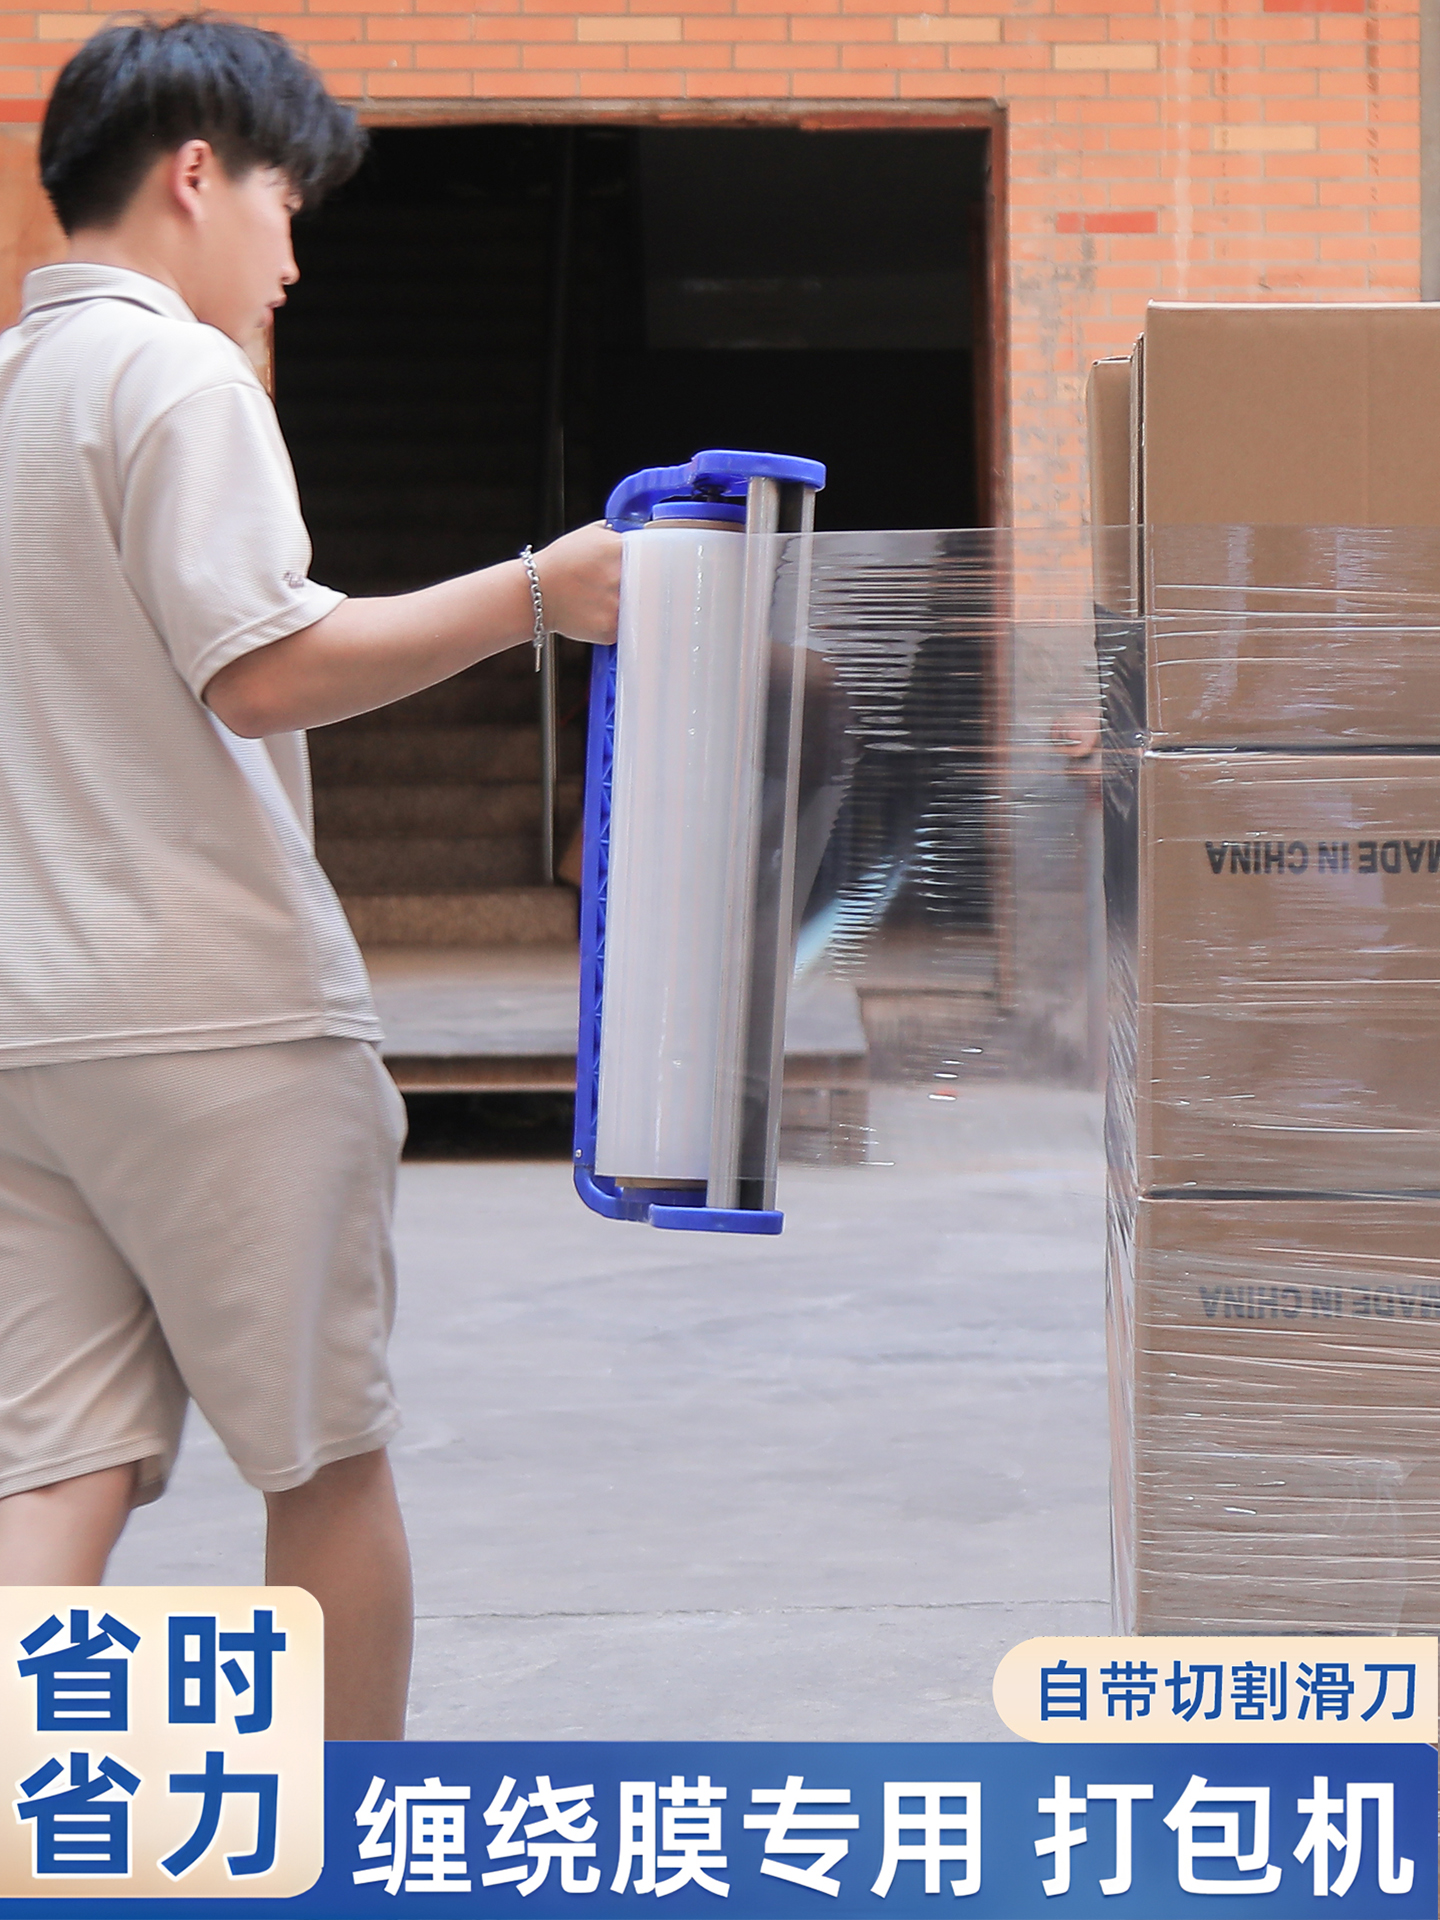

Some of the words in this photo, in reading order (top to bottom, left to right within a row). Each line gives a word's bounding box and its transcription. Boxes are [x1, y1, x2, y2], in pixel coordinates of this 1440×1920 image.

[1204, 840, 1309, 875] CHINA
[1317, 840, 1350, 874] IN
[1199, 1286, 1302, 1319] CHINA
[1311, 1286, 1343, 1319] IN
